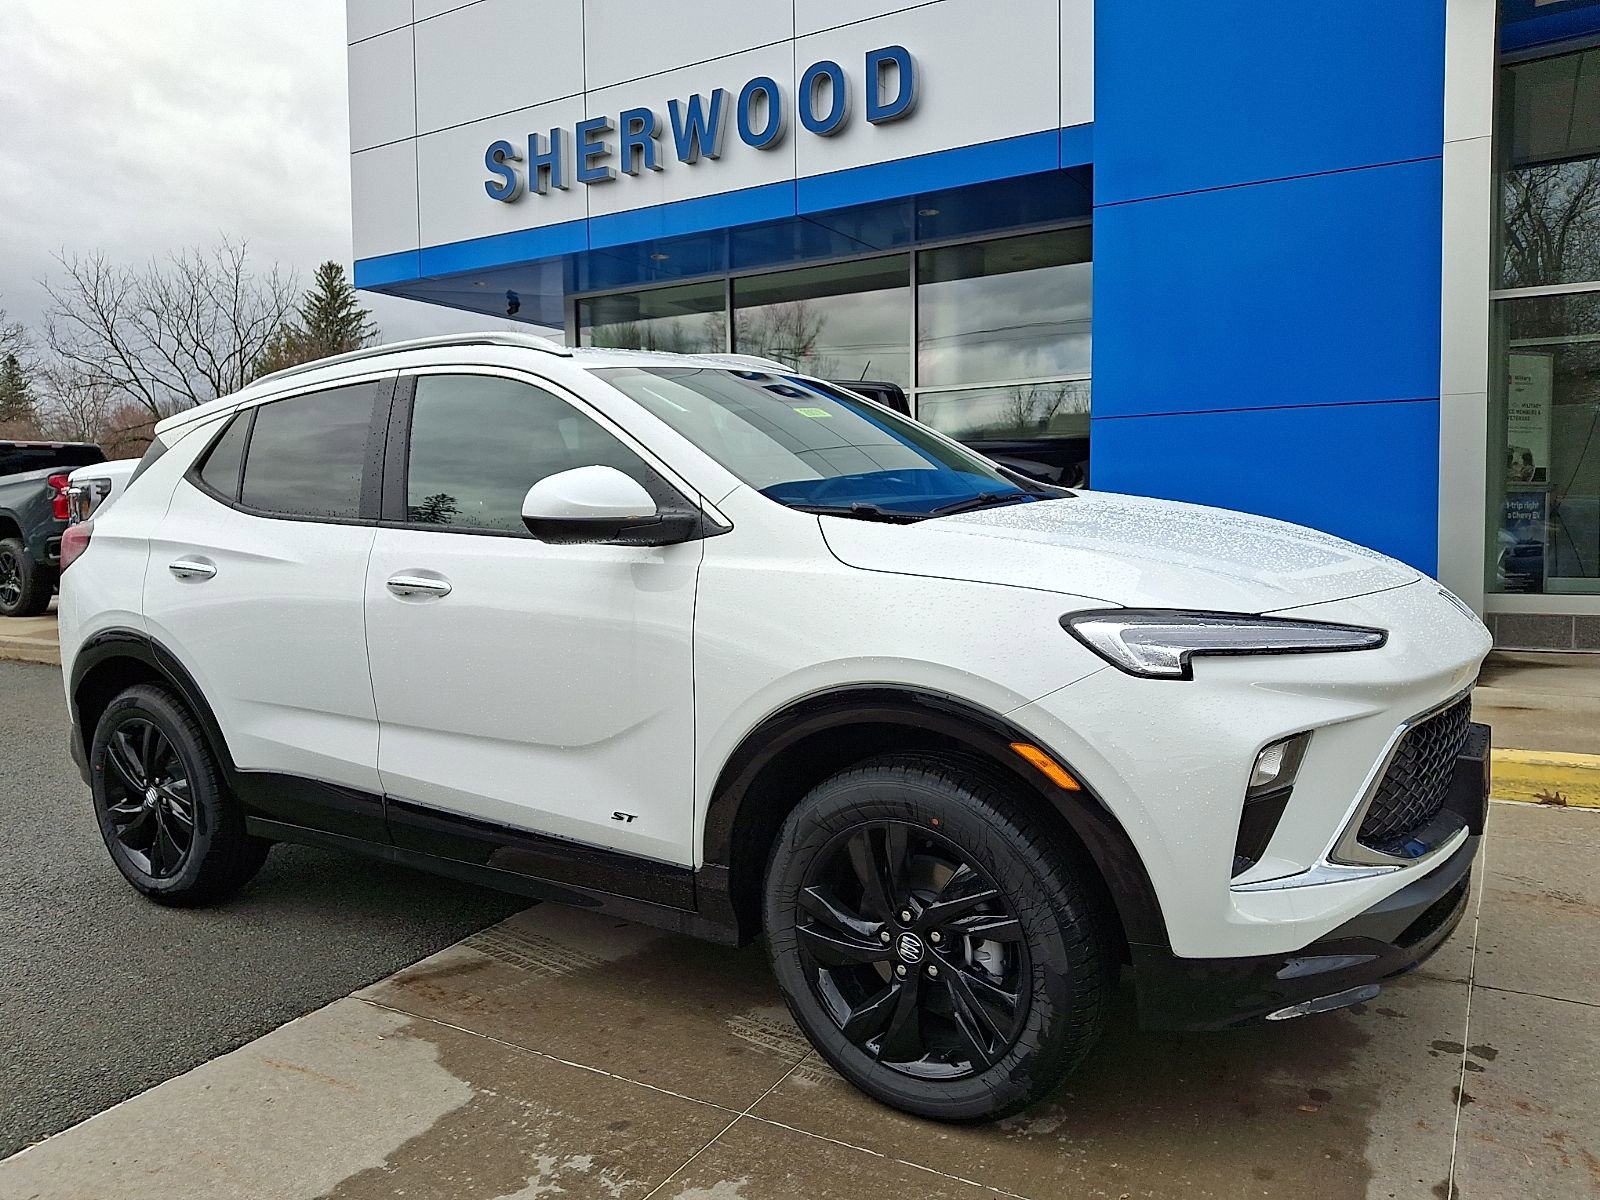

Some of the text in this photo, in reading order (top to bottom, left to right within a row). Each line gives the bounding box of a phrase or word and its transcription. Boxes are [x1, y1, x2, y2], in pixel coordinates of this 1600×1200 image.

[484, 45, 919, 203] SHERWOOD
[1524, 501, 1539, 510] right
[1513, 511, 1532, 520] Chevy
[1532, 511, 1541, 519] EV
[611, 811, 638, 823] ST
